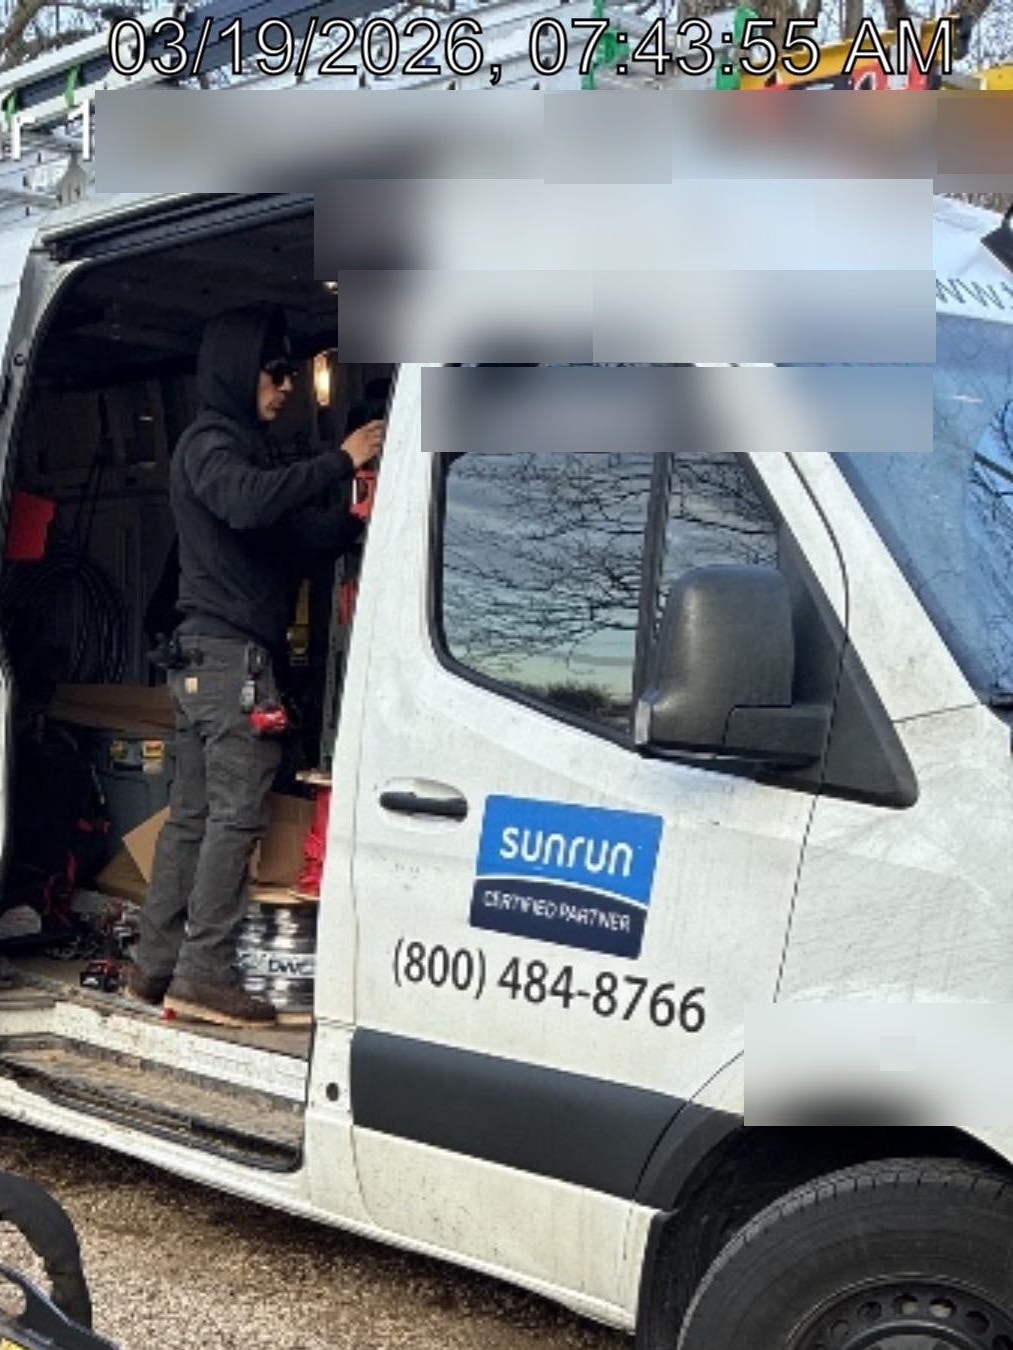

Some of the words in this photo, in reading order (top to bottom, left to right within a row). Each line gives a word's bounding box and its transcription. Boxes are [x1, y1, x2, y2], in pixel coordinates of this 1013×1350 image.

[499, 827, 634, 877] sunrun
[483, 890, 558, 919] CERTIFIED
[559, 903, 631, 934] PARTNER
[393, 936, 486, 1000] (800)
[497, 957, 706, 1033] 484-8766
